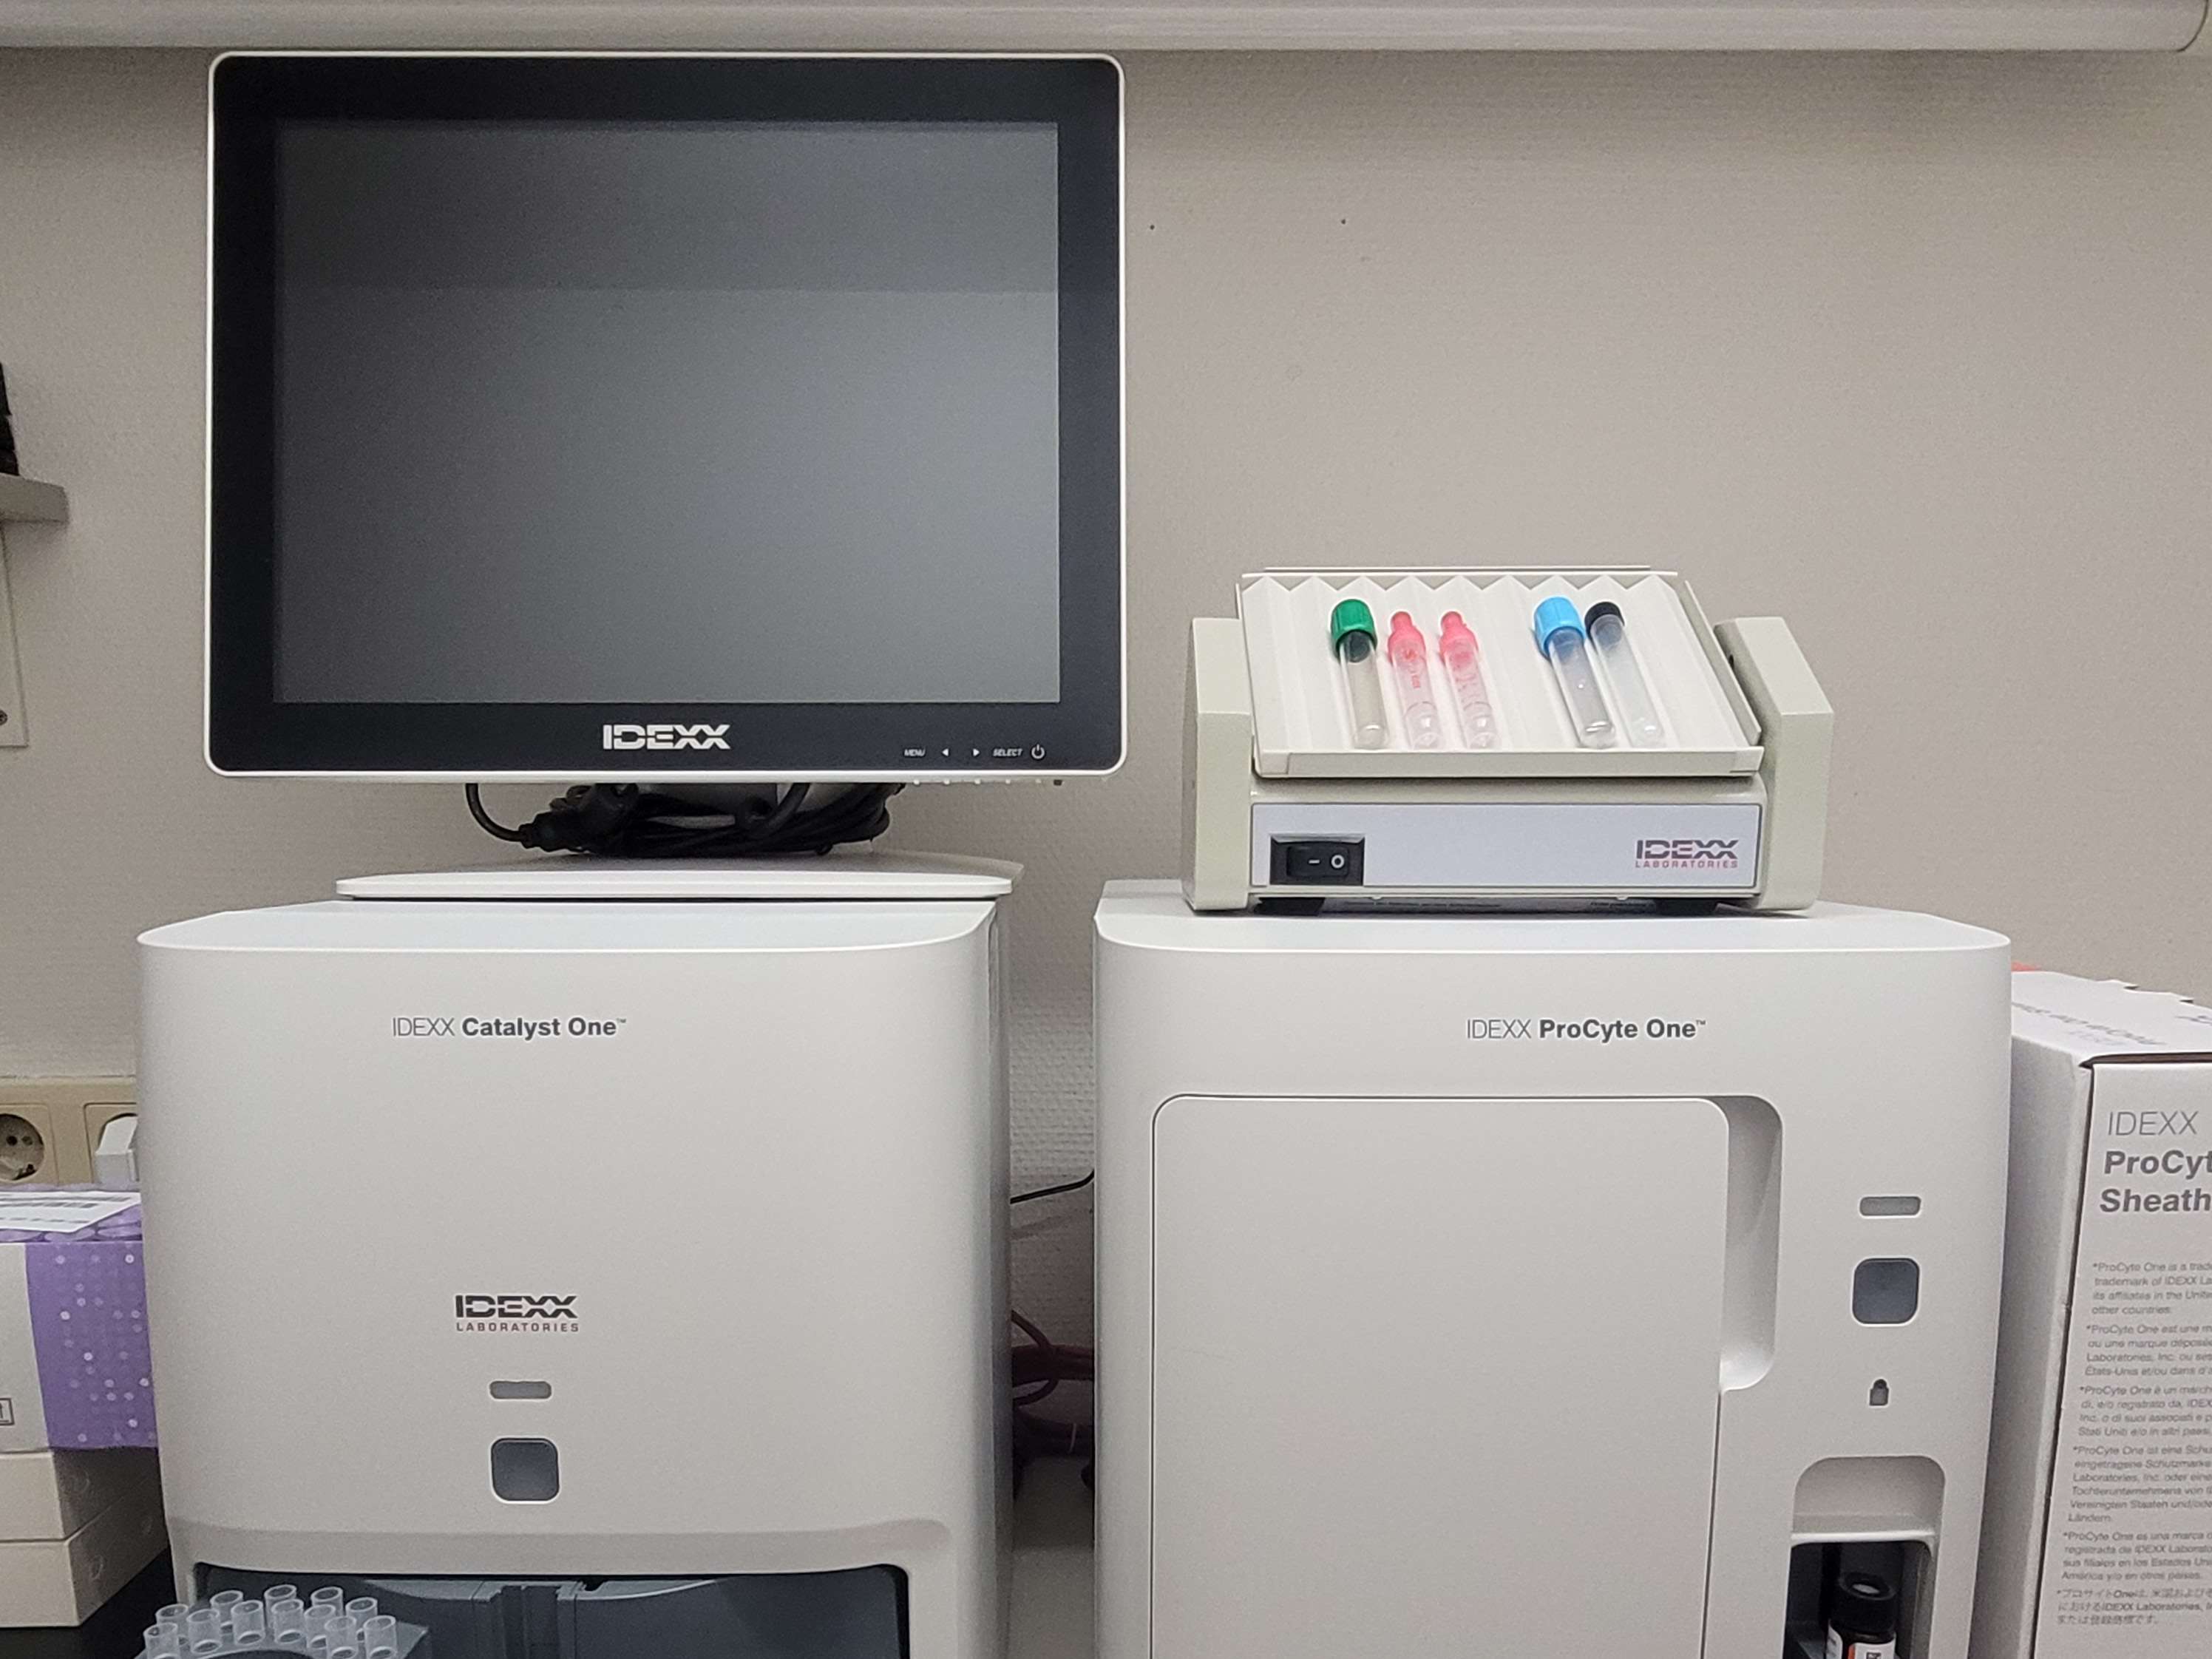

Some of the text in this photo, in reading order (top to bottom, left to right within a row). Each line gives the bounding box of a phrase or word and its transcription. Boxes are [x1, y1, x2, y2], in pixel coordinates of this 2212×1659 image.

[603, 724, 730, 750] IDEXX
[993, 748, 1022, 756] SELECT
[1636, 840, 1738, 859] IDEXX
[393, 1017, 455, 1036] IDEXX
[462, 1017, 560, 1040] Catalyst
[1467, 1020, 1532, 1039] IDEXX
[1539, 1019, 1638, 1043] ProCyte
[2108, 1110, 2198, 1135] IDEXX
[2100, 1188, 2211, 1212] Sheath
[2094, 1278, 2148, 1286] trademark
[2165, 1276, 2197, 1285] IDEXX
[455, 1295, 577, 1318] IDEXX
[456, 1323, 578, 1331] LABORATORIES
